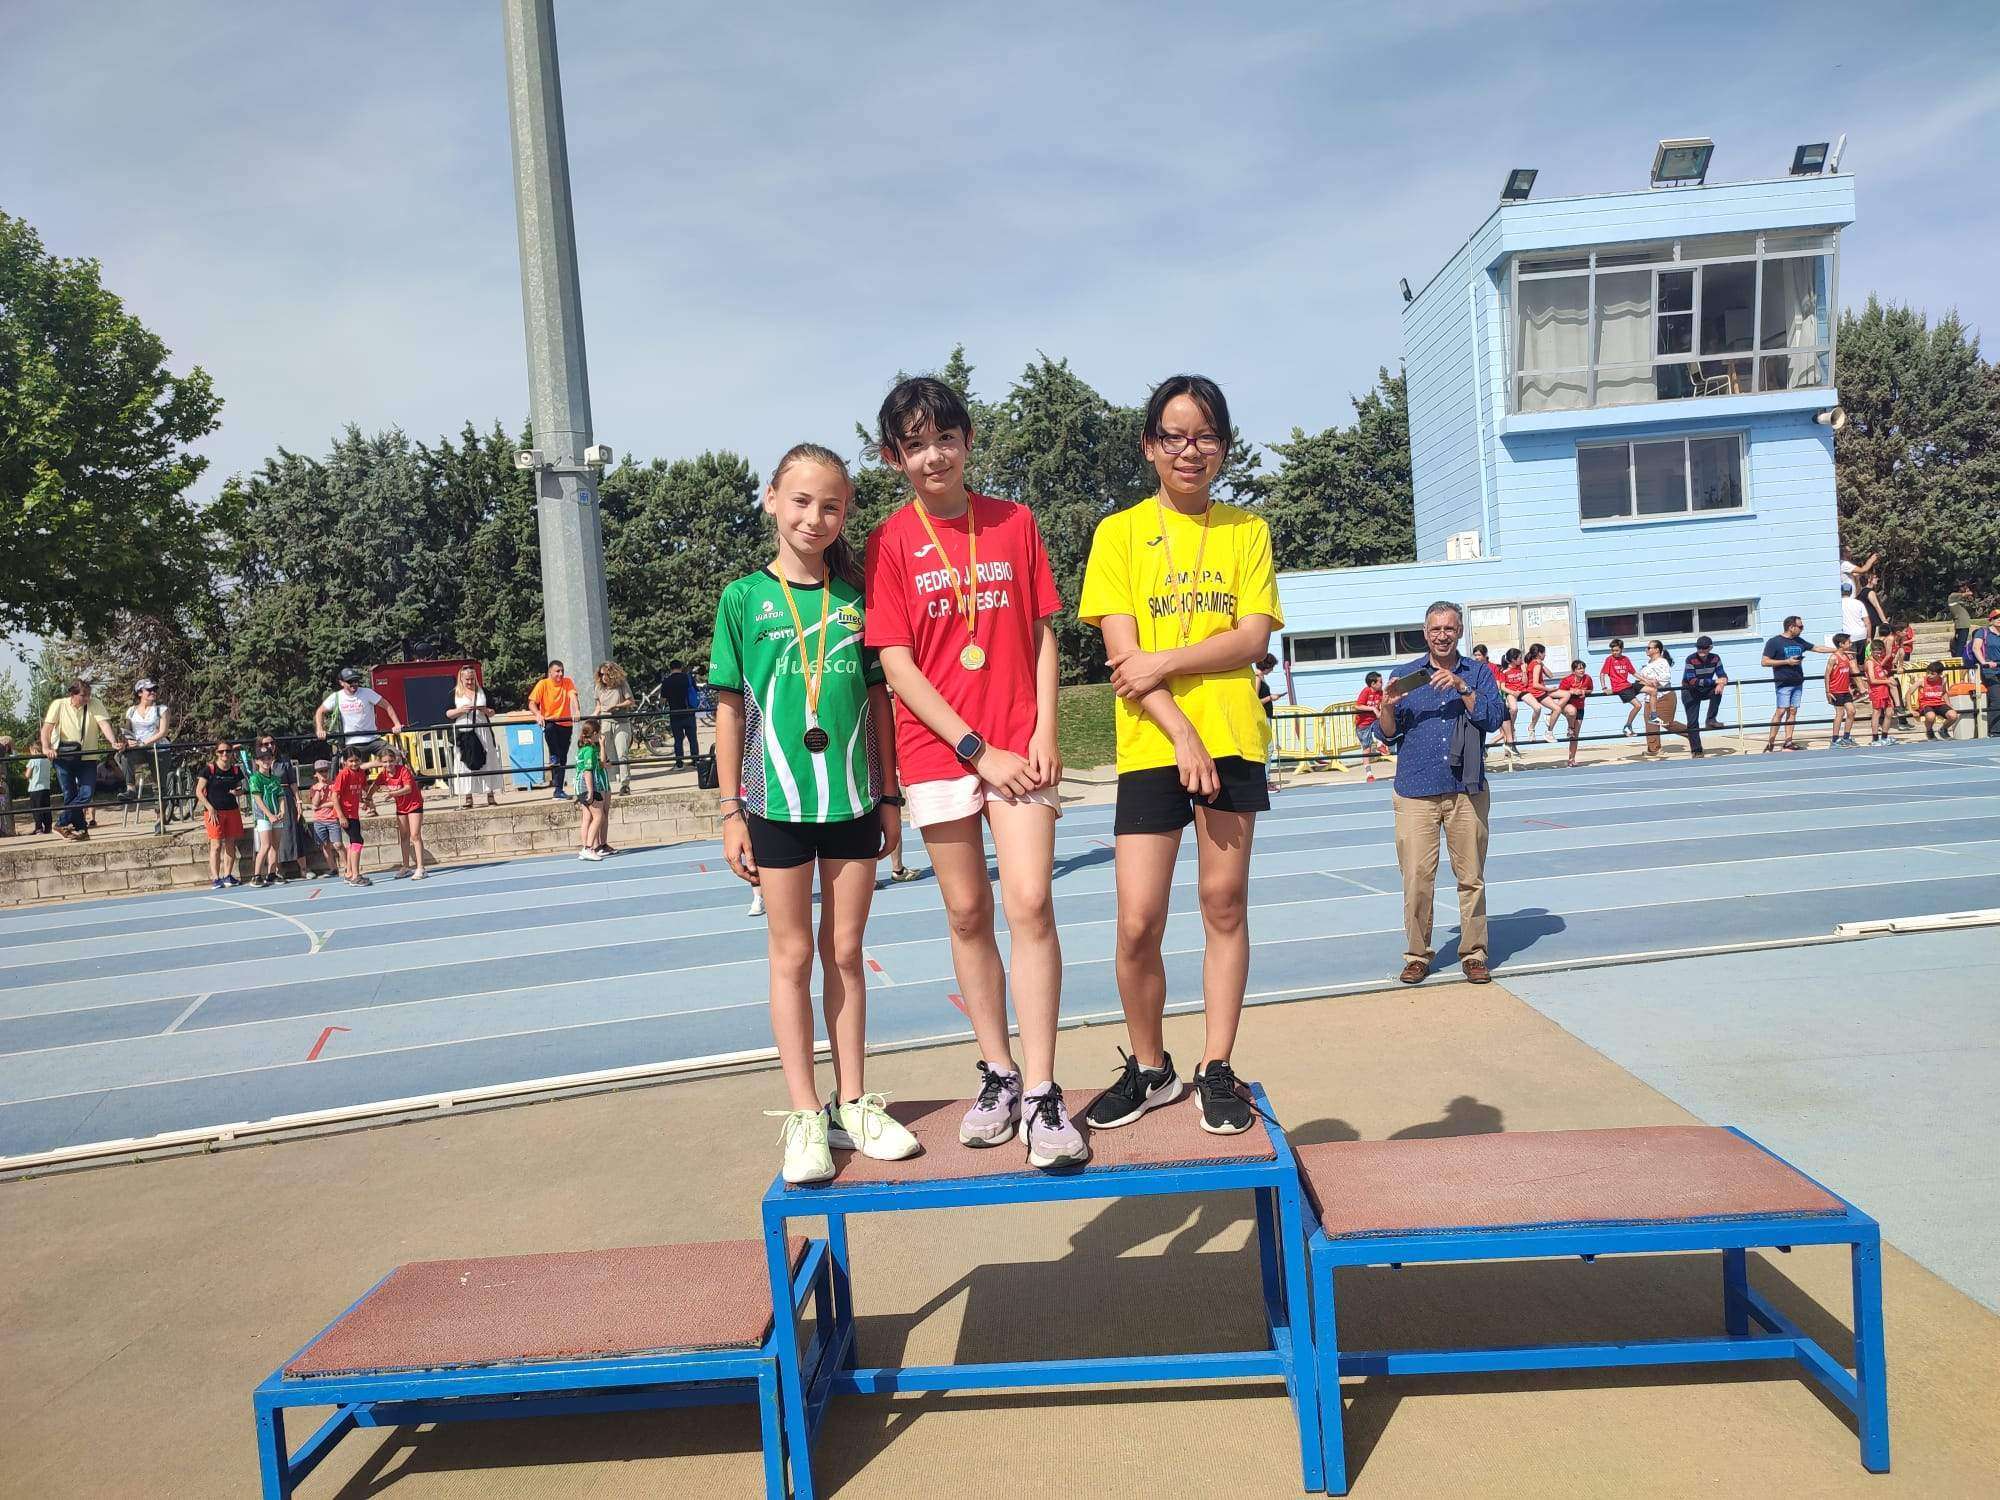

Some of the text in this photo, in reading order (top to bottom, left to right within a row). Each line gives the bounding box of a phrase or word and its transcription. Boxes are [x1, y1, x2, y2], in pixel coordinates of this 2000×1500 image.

[976, 562, 1013, 583] RUBIO
[928, 590, 1009, 618] C.P. HESCA
[775, 655, 857, 677] Huesca
